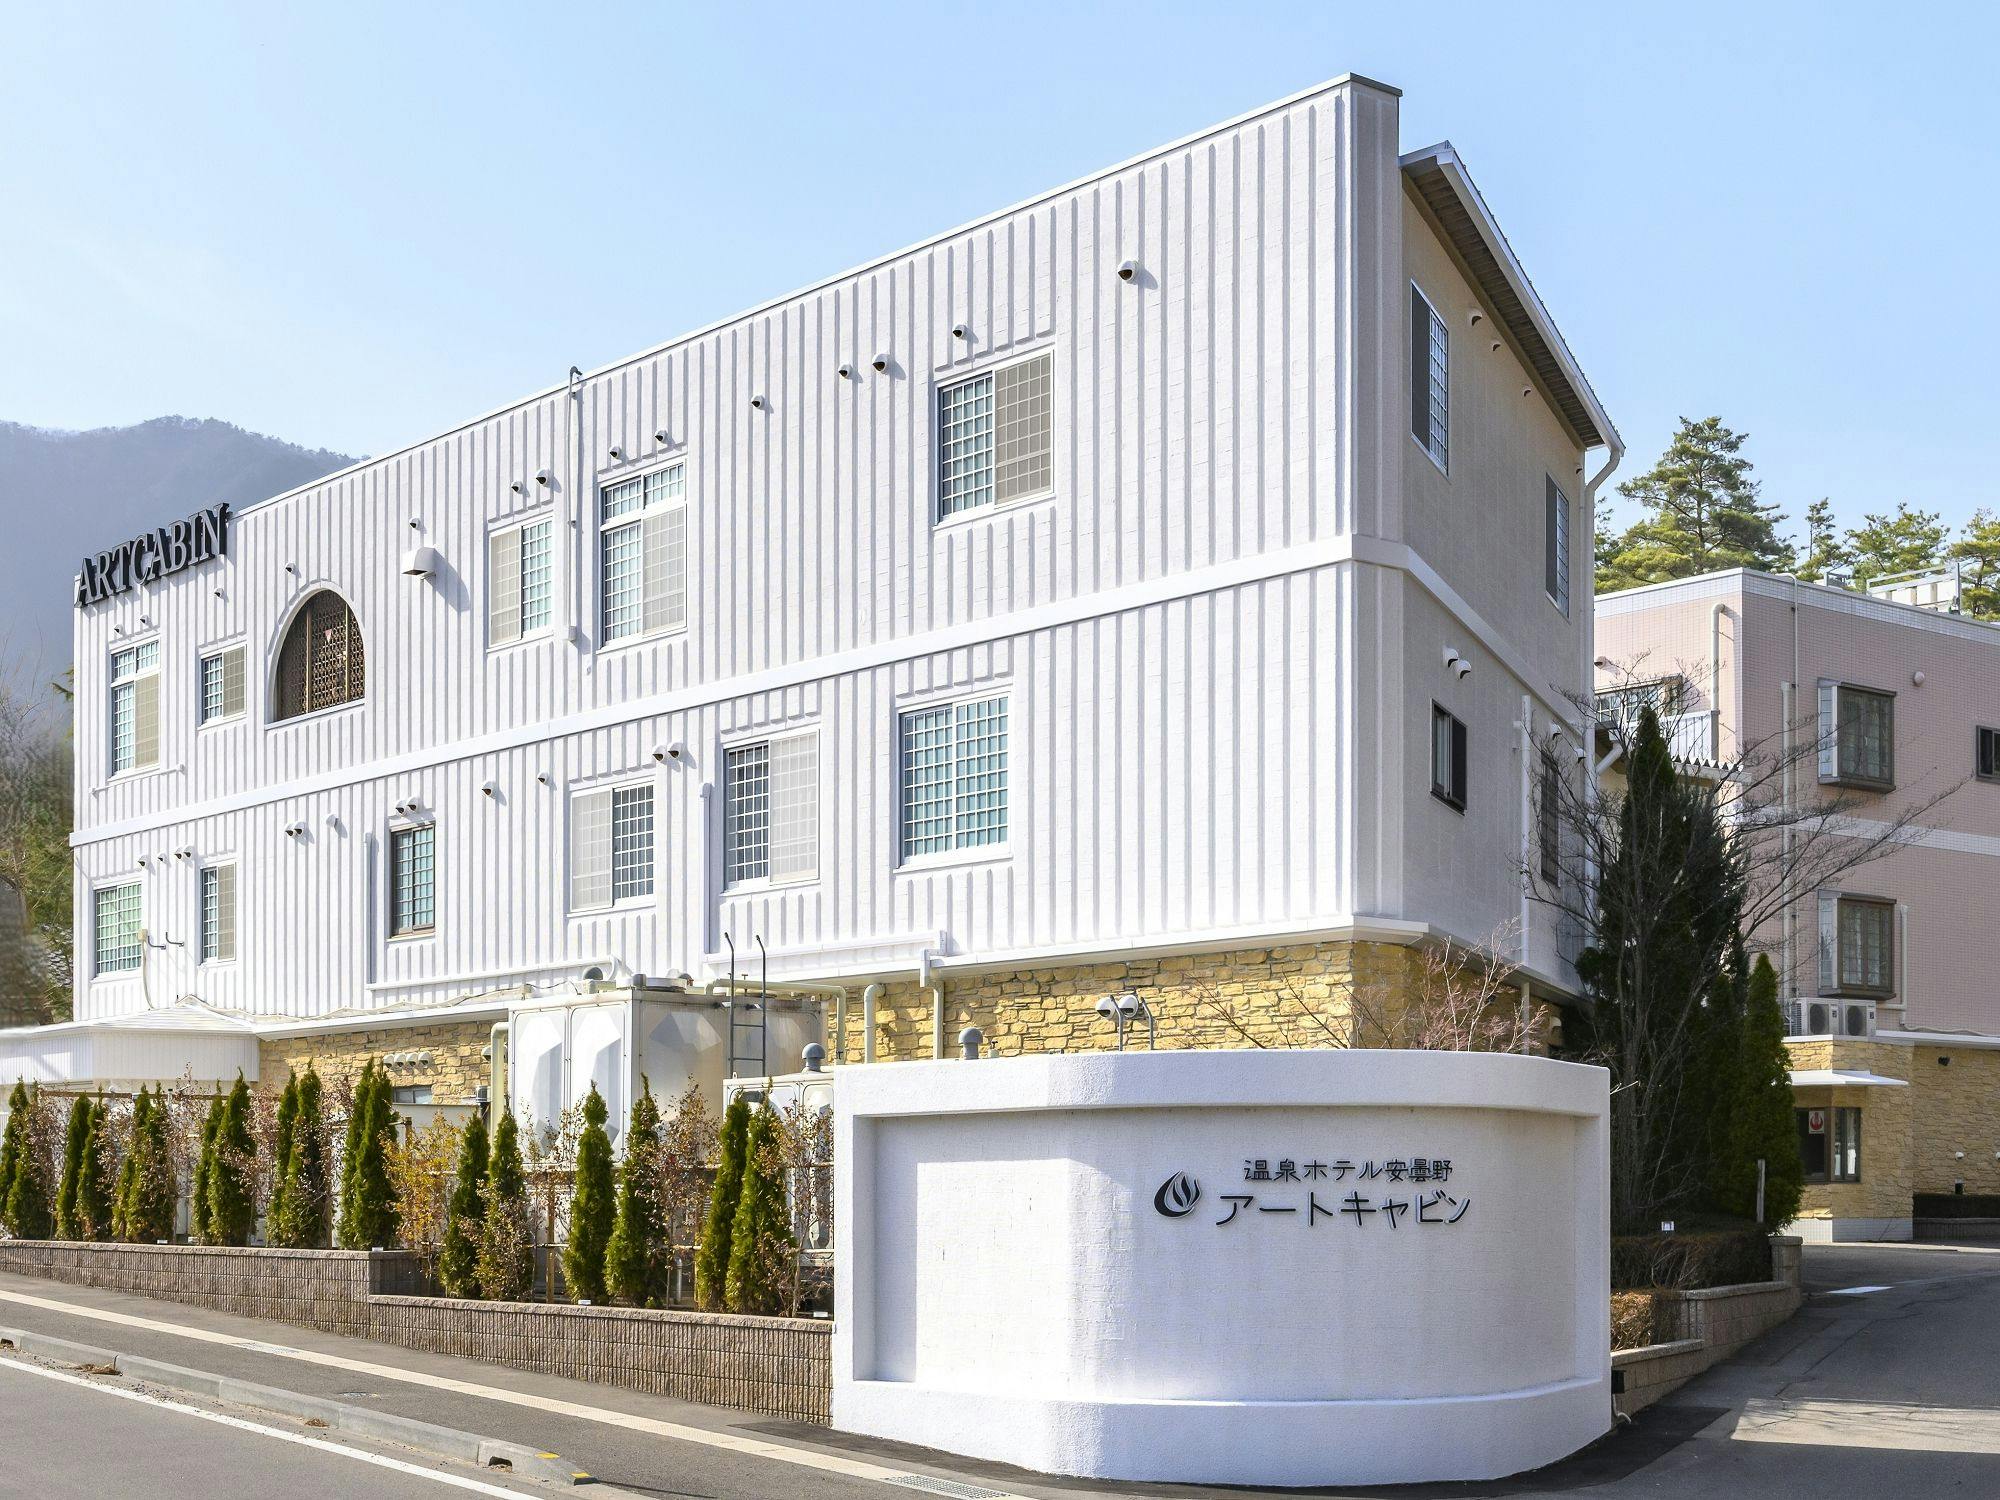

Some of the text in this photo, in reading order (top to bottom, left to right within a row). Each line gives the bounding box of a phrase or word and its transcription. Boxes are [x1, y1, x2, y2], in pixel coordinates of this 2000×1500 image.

[74, 502, 230, 607] ARTCABIN
[1243, 1158, 1453, 1182] 温泉ホテル安曇野
[1216, 1189, 1471, 1229] アートキャビン
